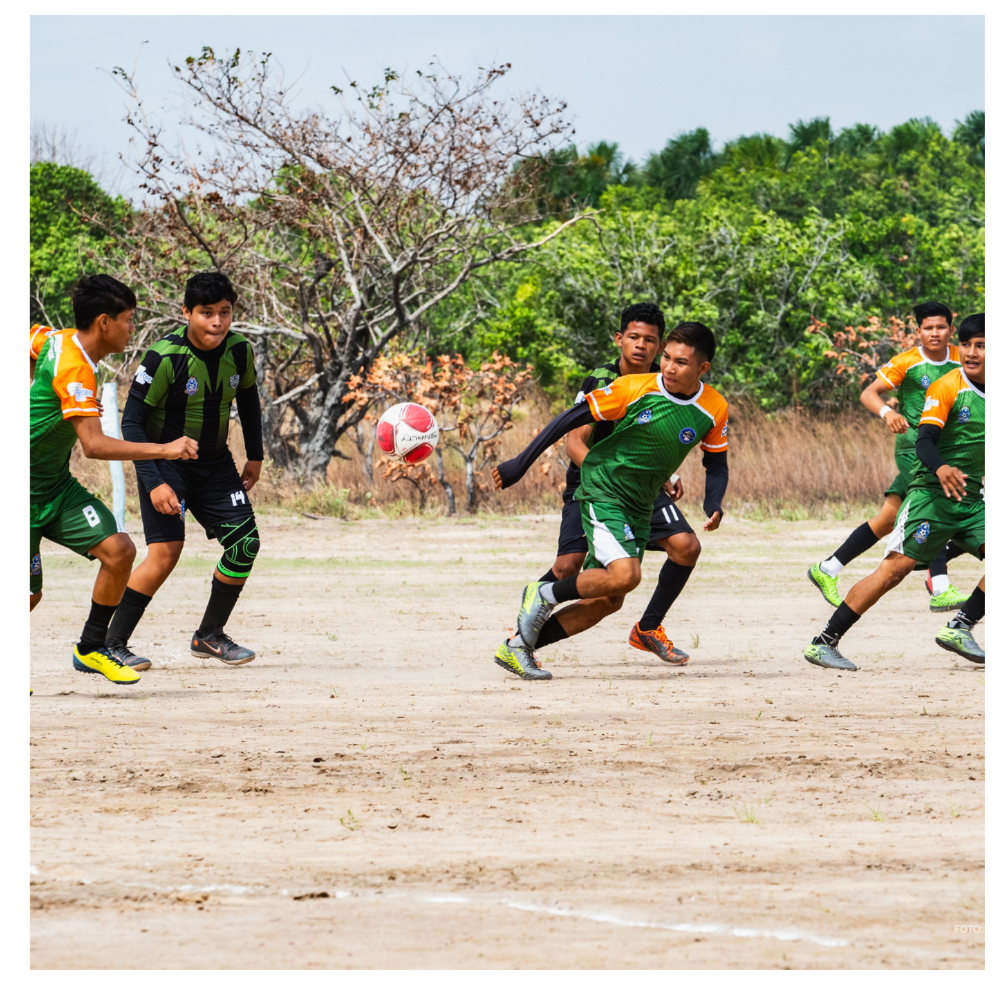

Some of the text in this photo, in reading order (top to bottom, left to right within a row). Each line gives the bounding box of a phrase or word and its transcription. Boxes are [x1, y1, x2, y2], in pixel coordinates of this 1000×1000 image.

[230, 490, 246, 507] 14
[82, 504, 101, 528] 8
[661, 504, 680, 525] 11
